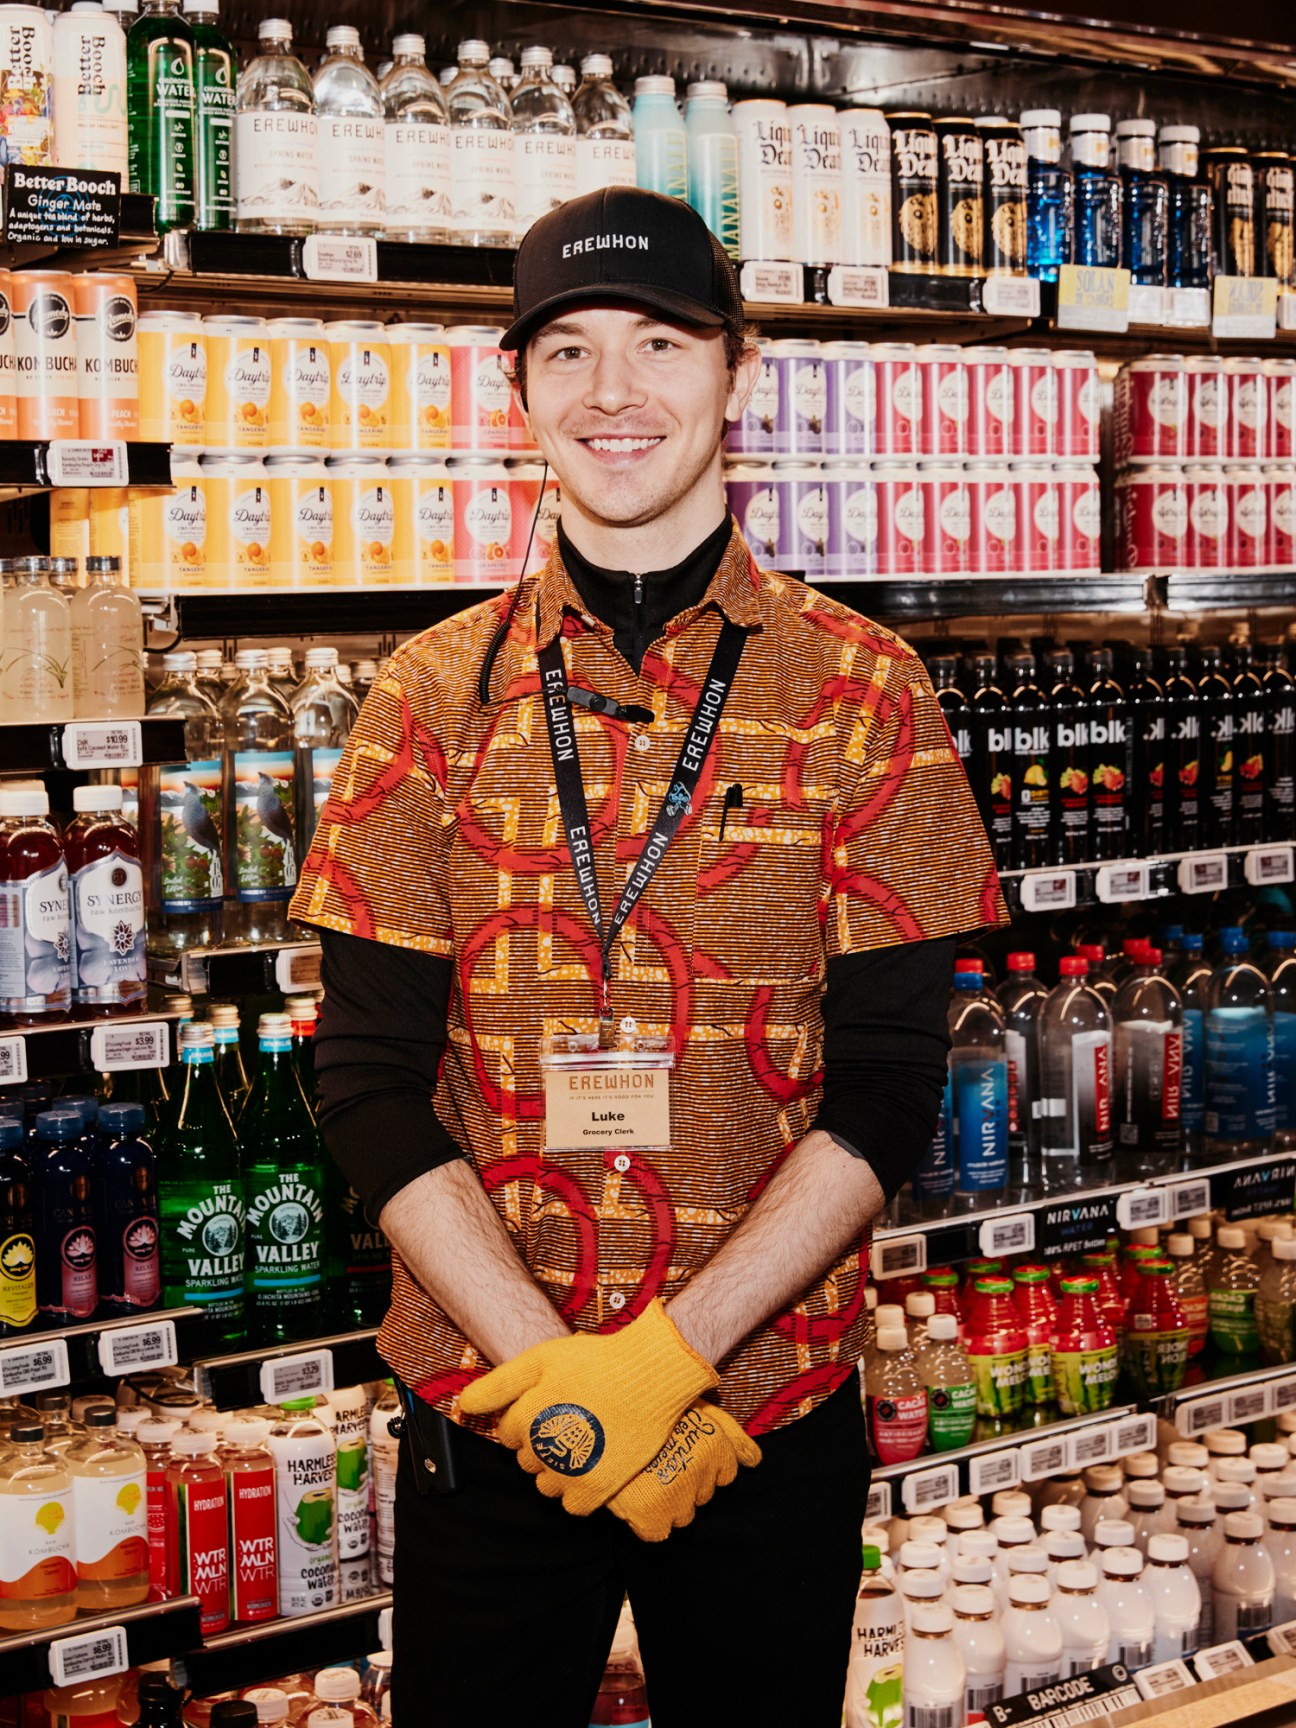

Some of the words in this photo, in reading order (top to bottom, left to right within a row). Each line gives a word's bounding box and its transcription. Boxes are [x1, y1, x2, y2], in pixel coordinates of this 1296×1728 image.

[78, 36, 91, 95] Better
[92, 36, 106, 95] Booch
[14, 172, 65, 192] Better
[66, 176, 116, 196] Booch
[28, 194, 71, 212] Ginger
[73, 198, 102, 212] Mate
[9, 207, 17, 219] A
[17, 211, 42, 222] unique
[81, 211, 91, 221] of
[8, 221, 54, 234] adaptogens
[56, 223, 71, 232] and
[7, 231, 41, 243] Organic
[43, 234, 58, 243] and
[61, 234, 74, 243] low
[75, 236, 82, 244] in
[83, 238, 109, 247] sugar.
[562, 234, 649, 259] EREWHON
[545, 669, 574, 761] EREWHON
[682, 678, 727, 772] EREWHON
[1090, 719, 1126, 744] blk
[106, 735, 128, 744] $10.99
[1014, 726, 1050, 751] blk
[570, 826, 600, 926] EREWHON
[614, 832, 668, 926] EREWHON
[135, 1036, 154, 1045] $3.99
[569, 1074, 655, 1091] EREWHON
[592, 1111, 625, 1121] Luke
[981, 1067, 996, 1157] NIRVANA
[279, 1173, 299, 1184] THE
[213, 1184, 231, 1195] THE
[246, 1183, 323, 1228] MOUNTAIN
[1047, 1204, 1109, 1225] NIRVANA
[256, 1241, 319, 1263] VALLEY
[254, 1265, 299, 1274] SPARKLING
[185, 1277, 229, 1288] SPARKLING
[142, 1335, 161, 1347] $6.99
[33, 1354, 52, 1366] $6.99
[238, 1484, 272, 1499] HYDRATION
[193, 1496, 225, 1511] HYDRATION
[28, 1543, 70, 1555] KOMBUCHA
[239, 1536, 274, 1553] WTR
[193, 1547, 226, 1566] WTR
[240, 1550, 274, 1568] MLN
[194, 1562, 227, 1581] MLN
[240, 1564, 275, 1582] WTR
[194, 1576, 228, 1596] WTR
[1026, 1675, 1095, 1712] BARCODE
